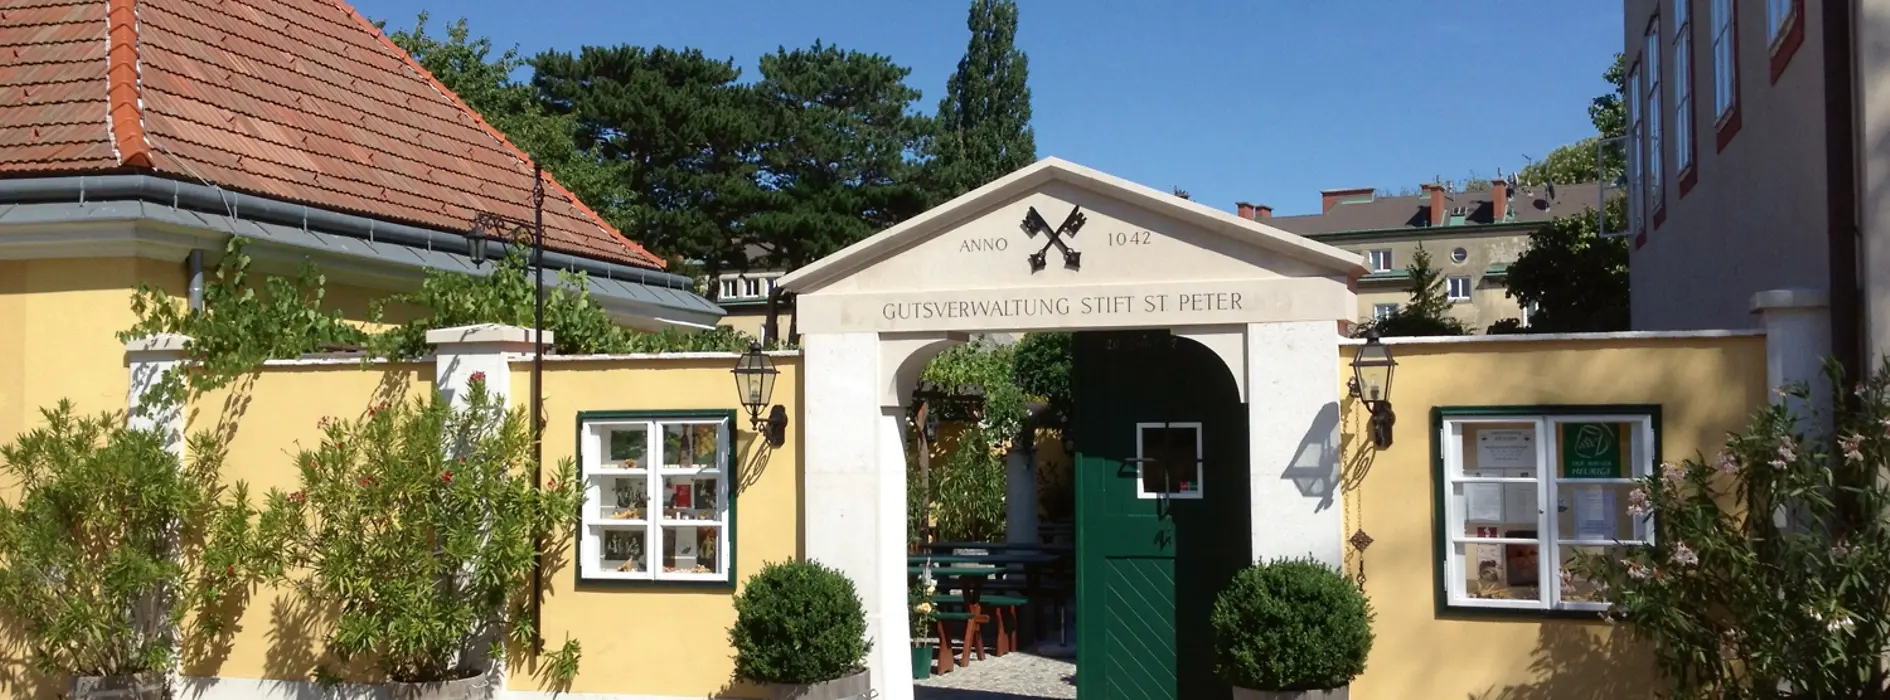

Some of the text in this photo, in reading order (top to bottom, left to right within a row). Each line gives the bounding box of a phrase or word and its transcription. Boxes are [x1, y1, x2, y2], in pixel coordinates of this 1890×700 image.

[959, 238, 1008, 252] ANNO
[1107, 231, 1151, 246] 1042
[882, 297, 1070, 320] GUTSVERWALTUNG
[1081, 296, 1136, 315] STIFT
[1179, 292, 1242, 312] PETER
